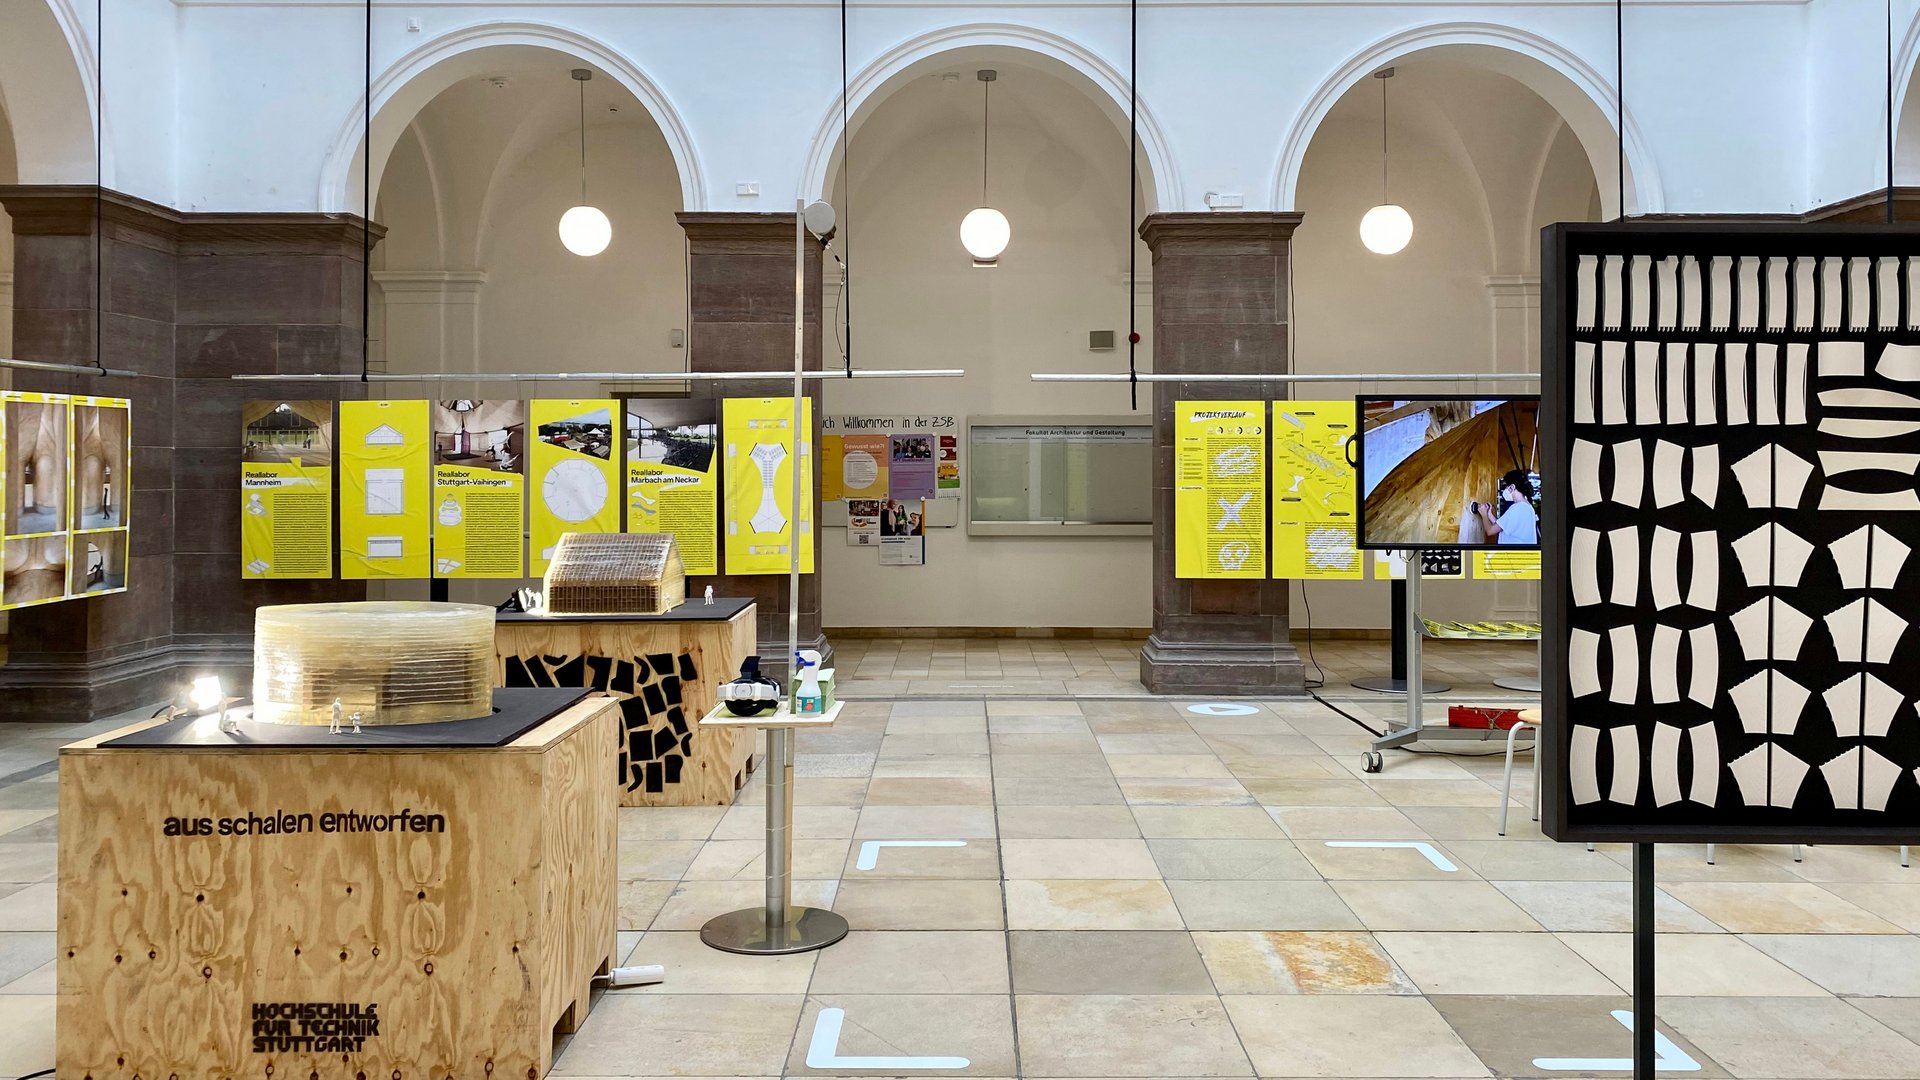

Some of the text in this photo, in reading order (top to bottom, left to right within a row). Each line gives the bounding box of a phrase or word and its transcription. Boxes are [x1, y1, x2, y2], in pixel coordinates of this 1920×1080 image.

[842, 416, 894, 429] Willkommen
[902, 417, 911, 428] in
[914, 416, 928, 428] der
[932, 416, 955, 428] ZSB
[437, 479, 506, 487] Stuttgart-Vaihingen
[163, 808, 445, 837] aus schalen entworfen
[252, 1003, 378, 1020] HOCHSCHULE
[298, 1019, 380, 1036] TECHNIK
[252, 1036, 366, 1053] STUTTGART
